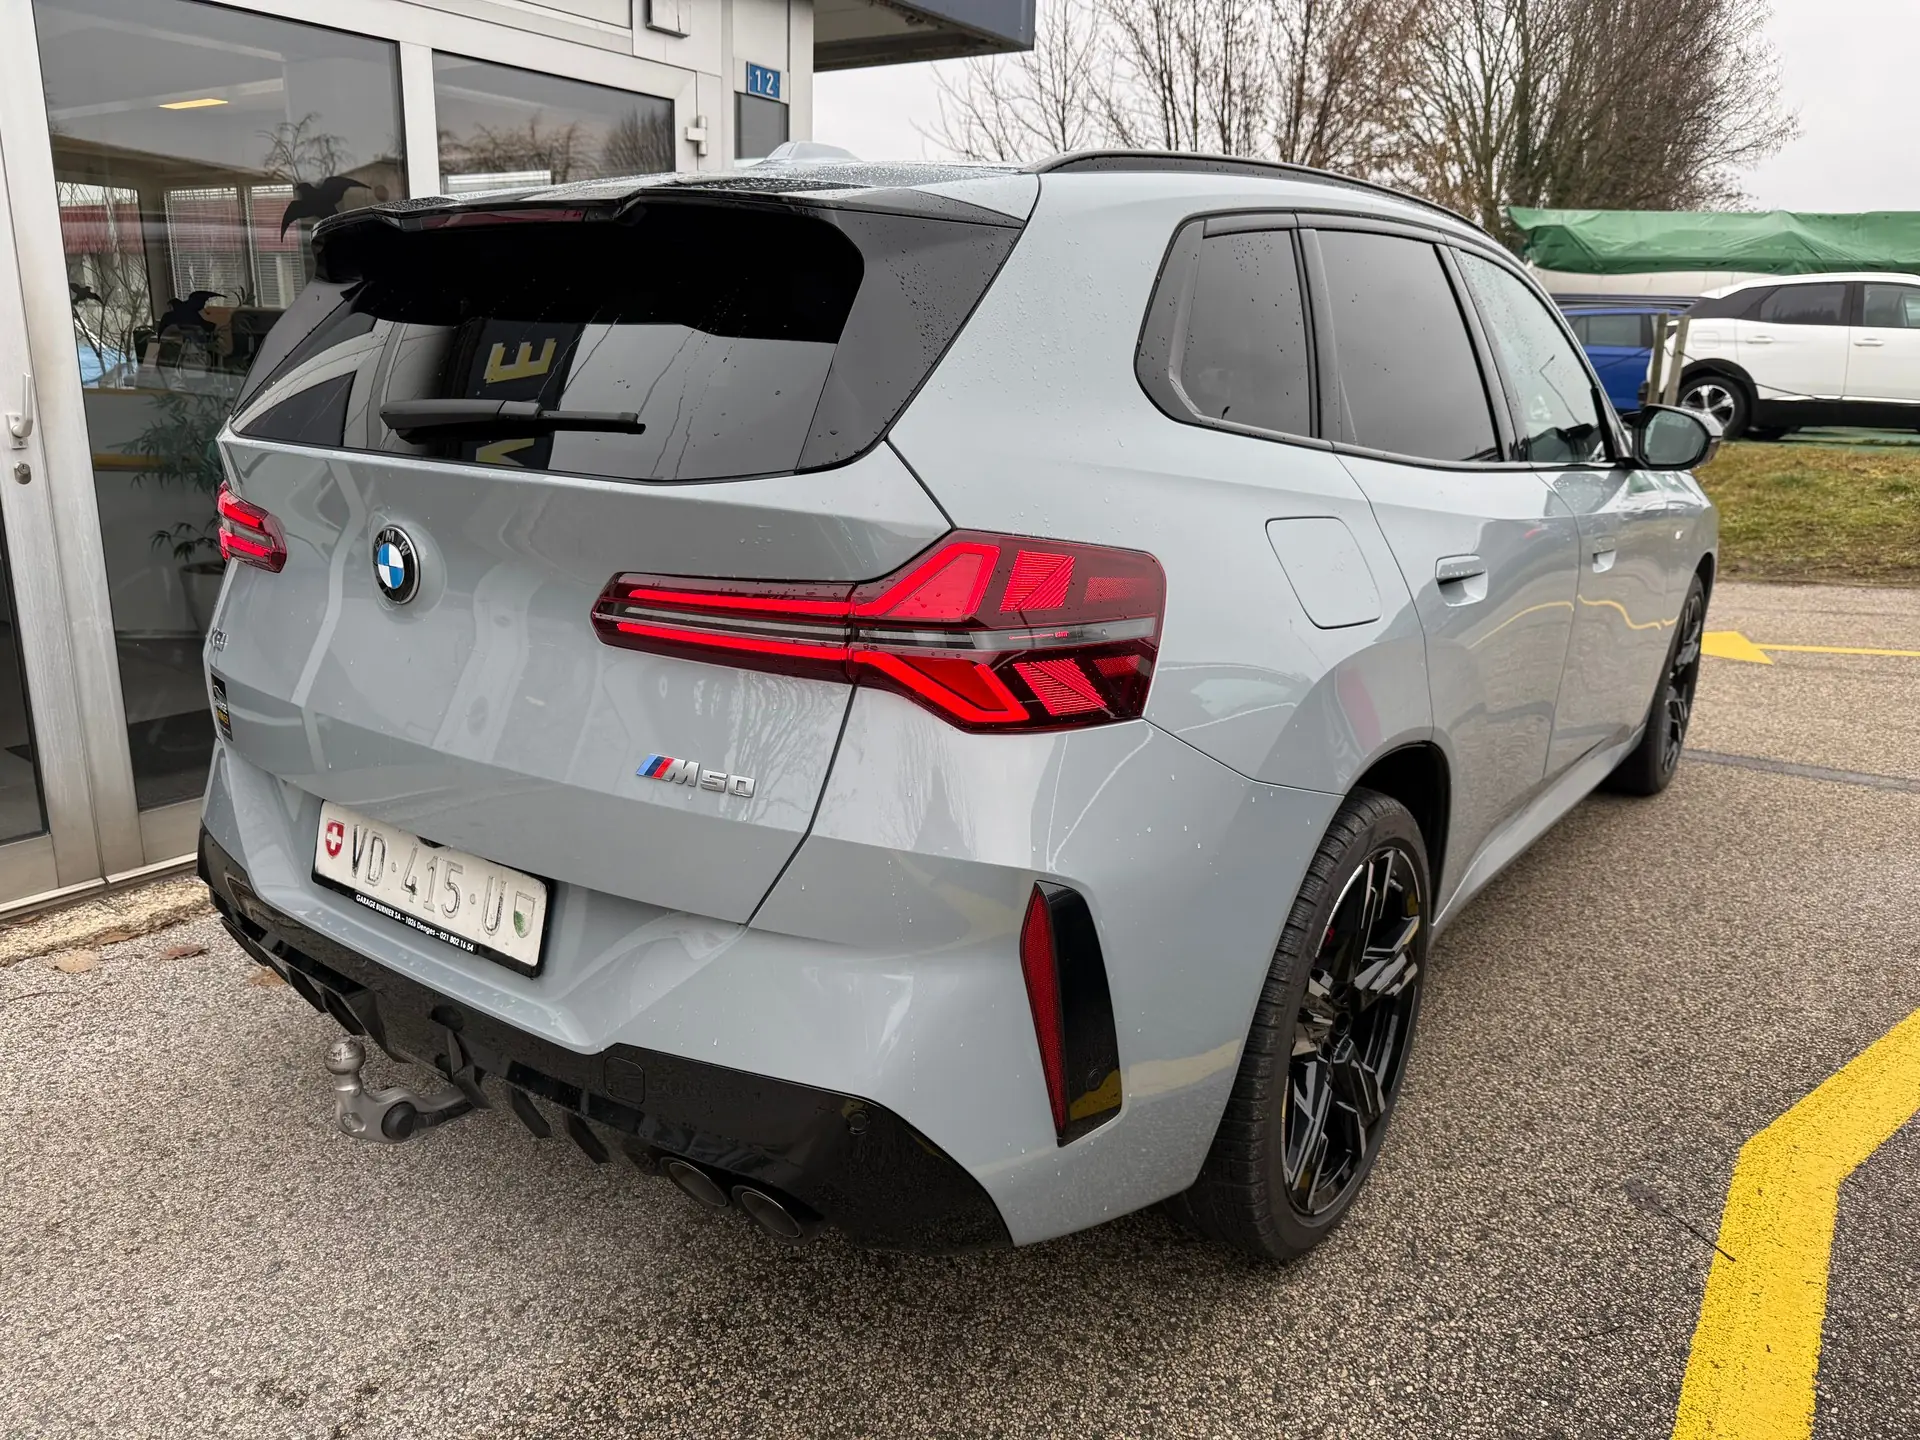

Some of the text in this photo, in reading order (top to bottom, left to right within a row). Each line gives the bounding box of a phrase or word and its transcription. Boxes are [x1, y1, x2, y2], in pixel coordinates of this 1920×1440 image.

[755, 70, 774, 94] 12
[659, 757, 756, 798] M50
[356, 894, 376, 909] GARAGE
[376, 903, 394, 917] BURNIER
[394, 911, 401, 920] SA
[405, 916, 416, 928] 1026
[417, 921, 436, 935] Denges
[440, 931, 449, 941] 021
[450, 936, 460, 946] 802
[460, 940, 466, 949] 16
[467, 943, 474, 952] 54
